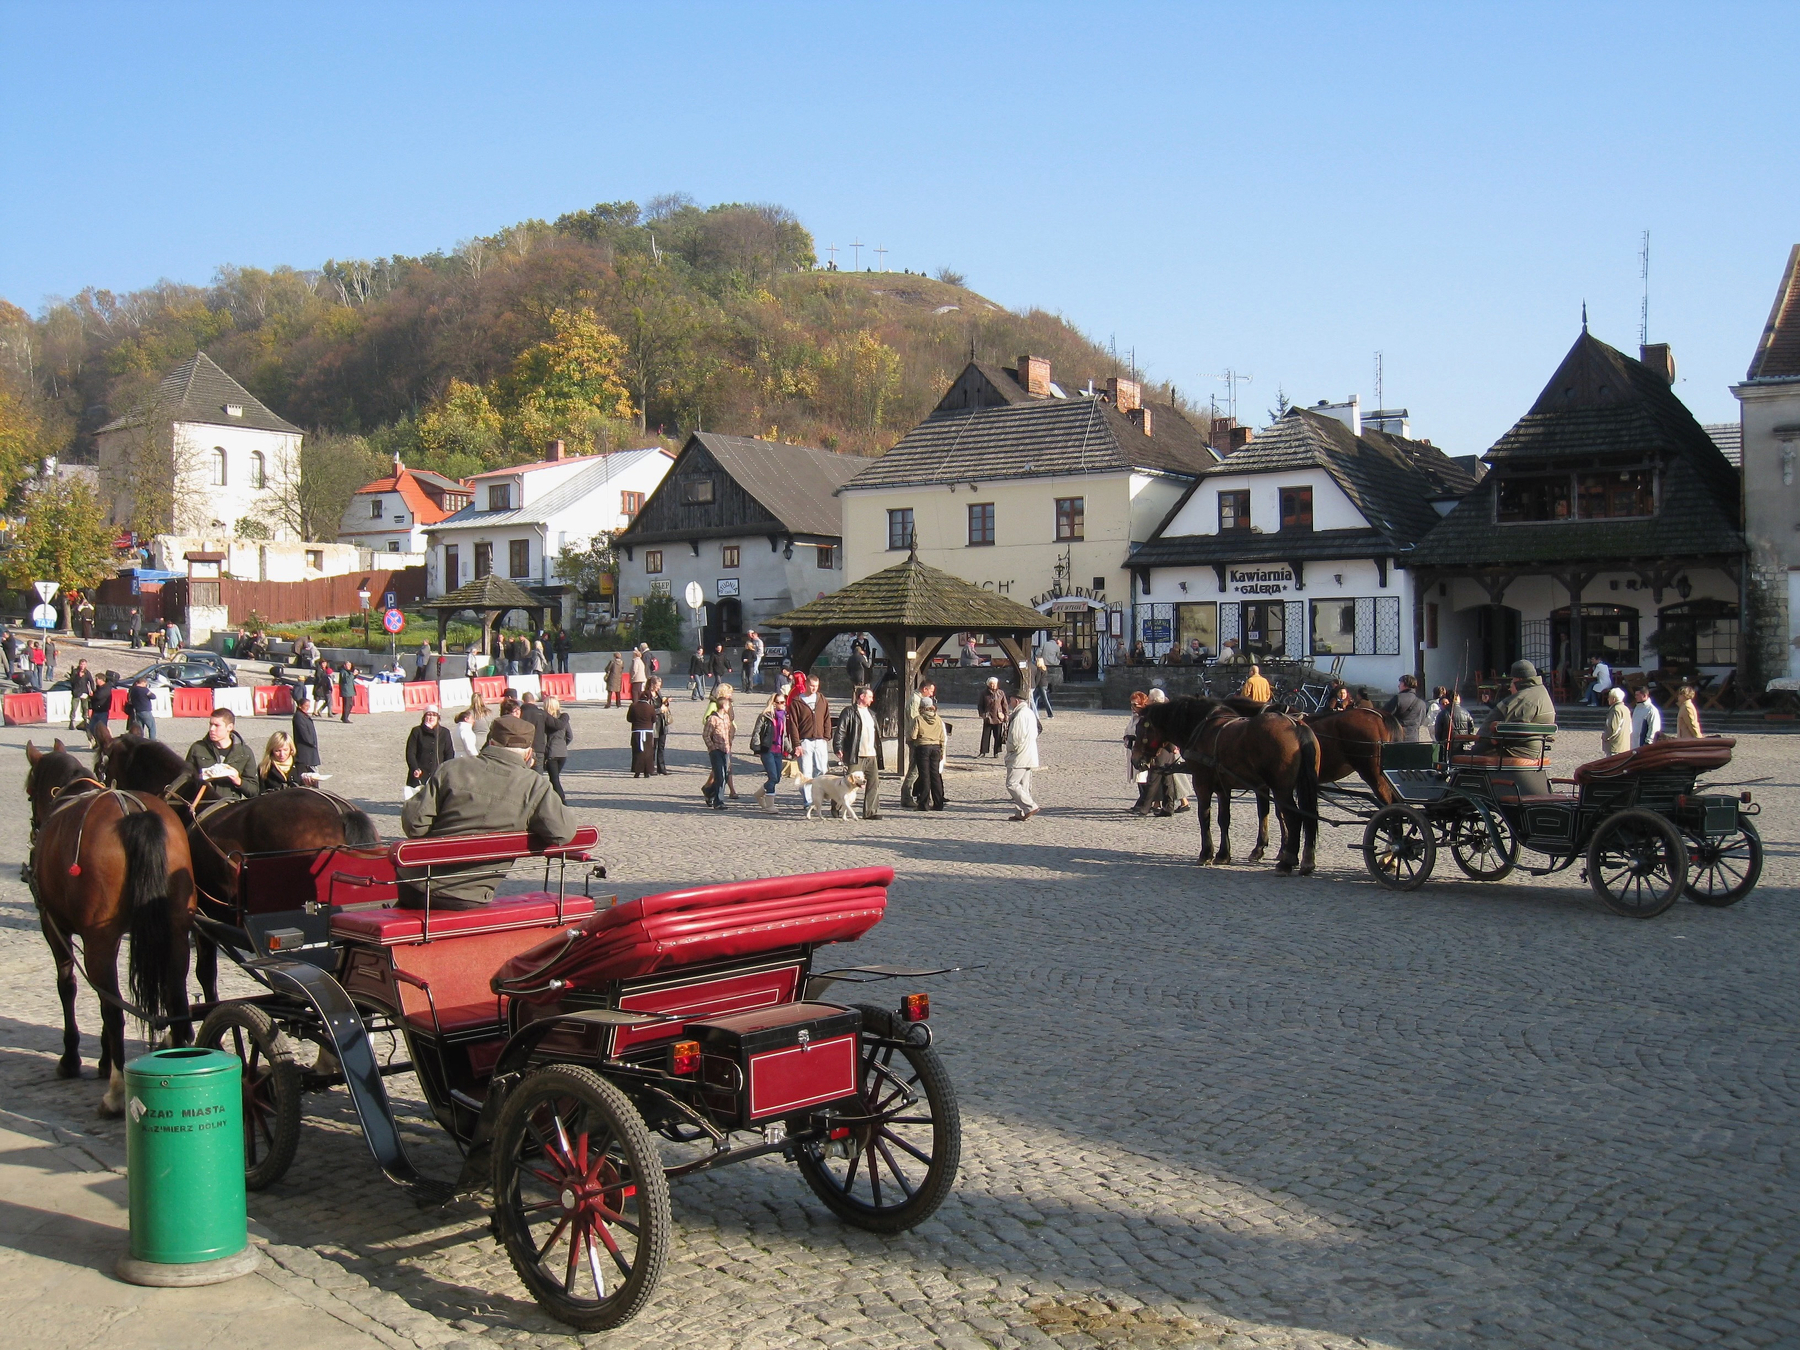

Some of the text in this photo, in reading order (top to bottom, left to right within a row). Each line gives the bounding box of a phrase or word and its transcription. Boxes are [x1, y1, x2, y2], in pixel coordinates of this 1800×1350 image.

[1230, 567, 1292, 582] Kawiarnia
[1240, 583, 1282, 596] GALERIA
[1030, 587, 1106, 608] KAWIARNIA
[36, 618, 55, 627] TAXI
[182, 1106, 225, 1118] MIASTA
[199, 1120, 227, 1131] DOLNY
